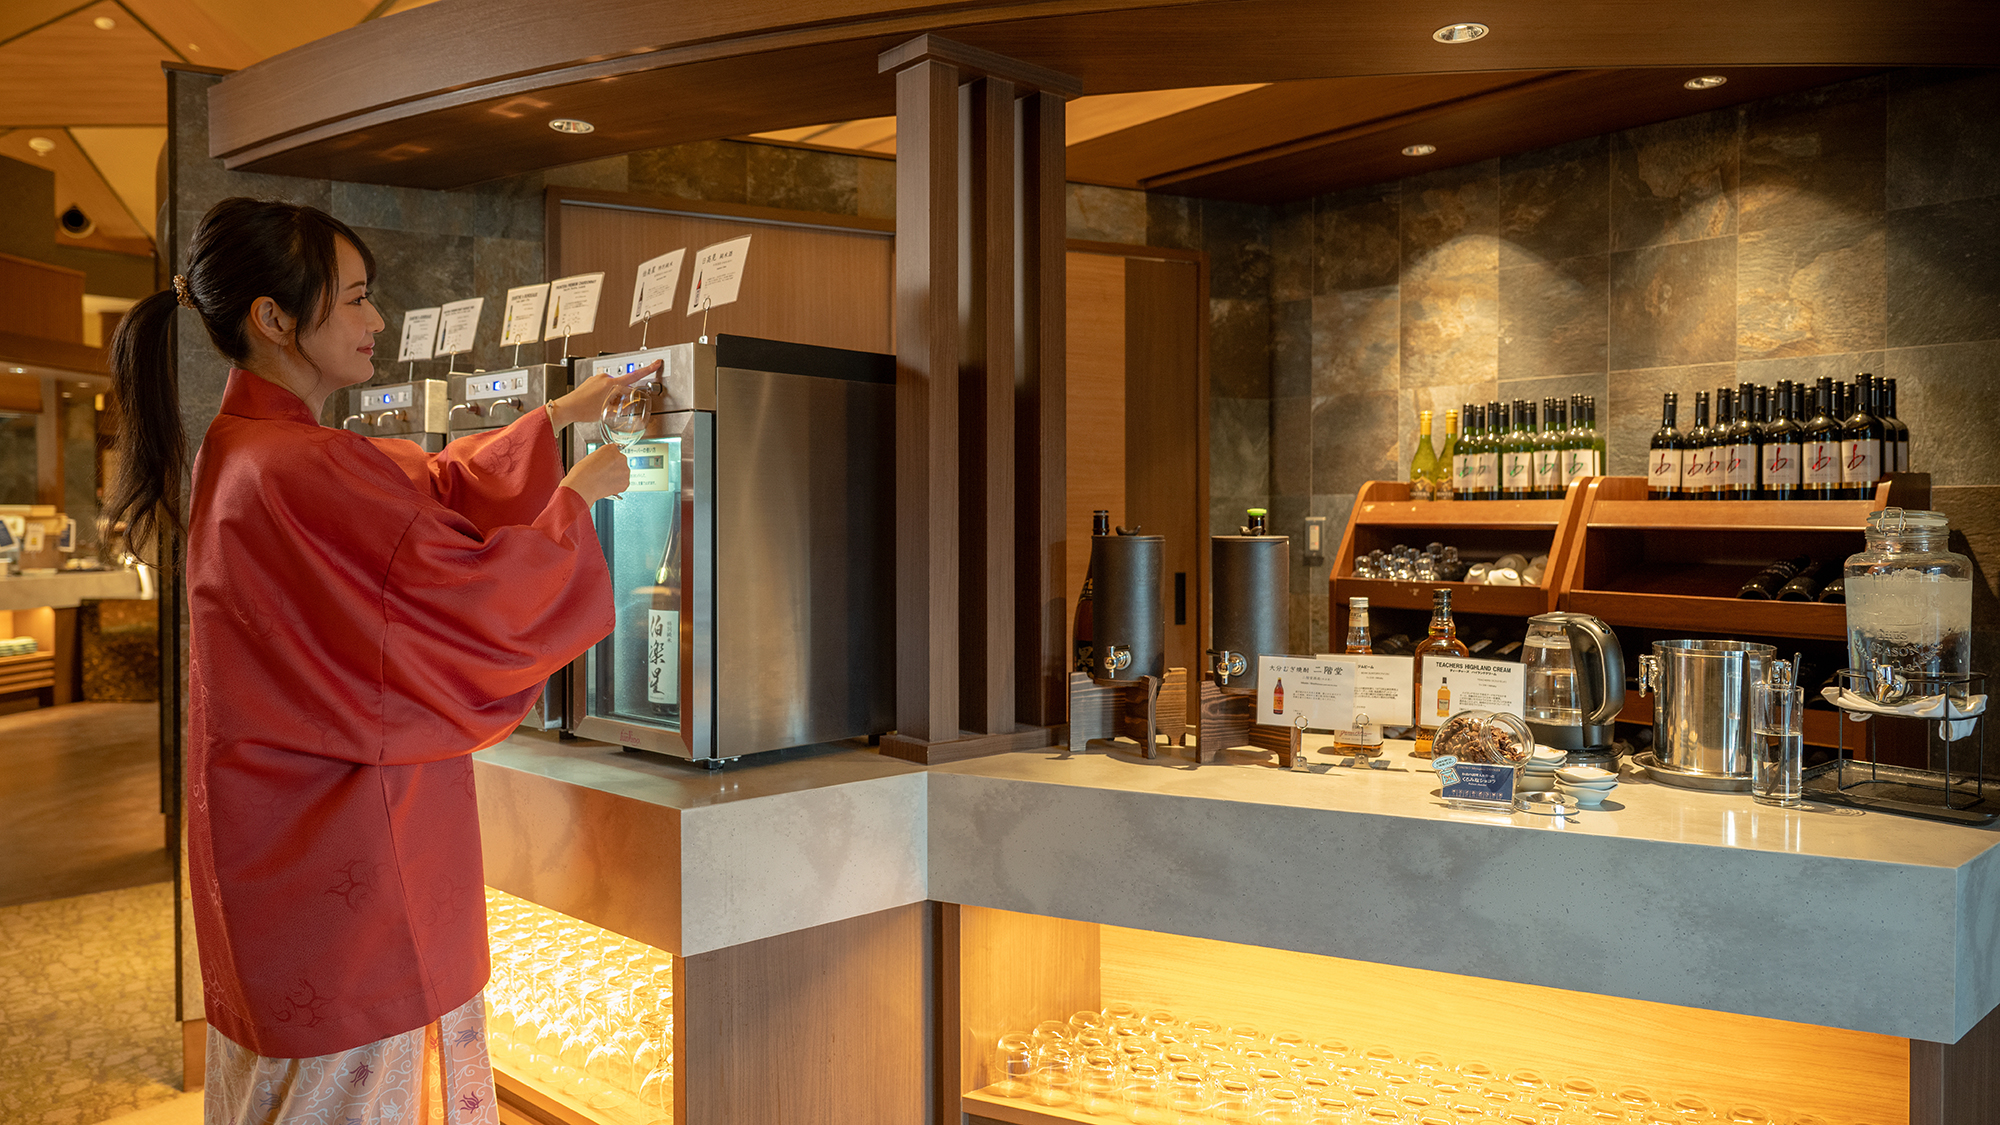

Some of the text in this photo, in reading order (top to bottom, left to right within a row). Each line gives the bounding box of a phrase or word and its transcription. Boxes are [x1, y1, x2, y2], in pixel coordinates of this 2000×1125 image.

[1269, 665, 1343, 675] 大分むぎ焼酎 二階堂
